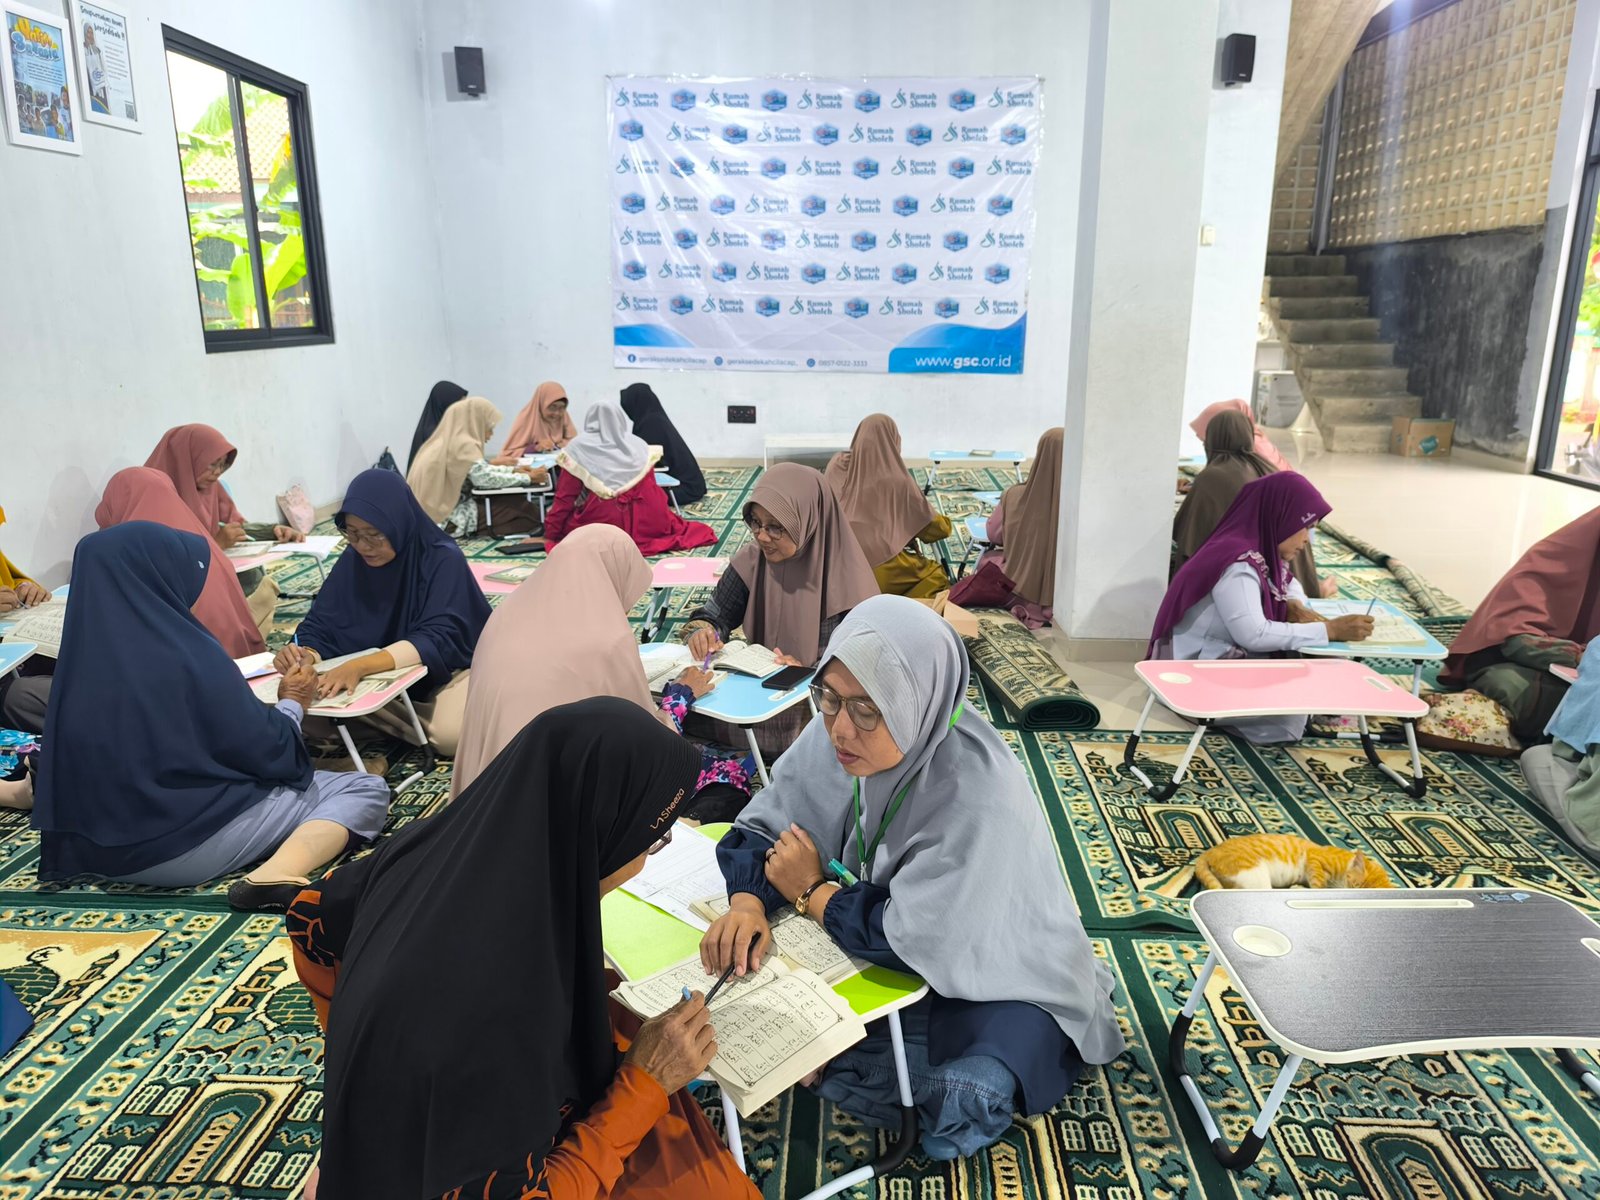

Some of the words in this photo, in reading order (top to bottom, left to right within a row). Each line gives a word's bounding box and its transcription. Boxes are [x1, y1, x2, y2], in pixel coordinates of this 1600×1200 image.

[632, 92, 658, 100] Rumah
[723, 93, 749, 101] Rumah
[816, 93, 842, 102] Rumah
[910, 92, 936, 101] Rumah
[775, 127, 800, 135] Rumah
[867, 127, 894, 135] Rumah
[815, 161, 841, 169] Rumah
[910, 160, 936, 168] Rumah
[855, 198, 881, 206] Rumah
[949, 197, 975, 205] Rumah
[637, 230, 662, 238] Rumah
[723, 232, 749, 240] Rumah
[814, 233, 839, 241] Rumah
[999, 233, 1024, 241] Rumah
[764, 265, 789, 274] Rumah
[854, 266, 880, 274] Rumah
[947, 266, 973, 274] Rumah
[632, 296, 657, 304] Rumah
[719, 298, 744, 306] Rumah
[807, 300, 832, 308] Rumah
[897, 300, 922, 308] Rumah
[992, 300, 1018, 308] Rumah
[915, 355, 1011, 368] www.gsc.or.id
